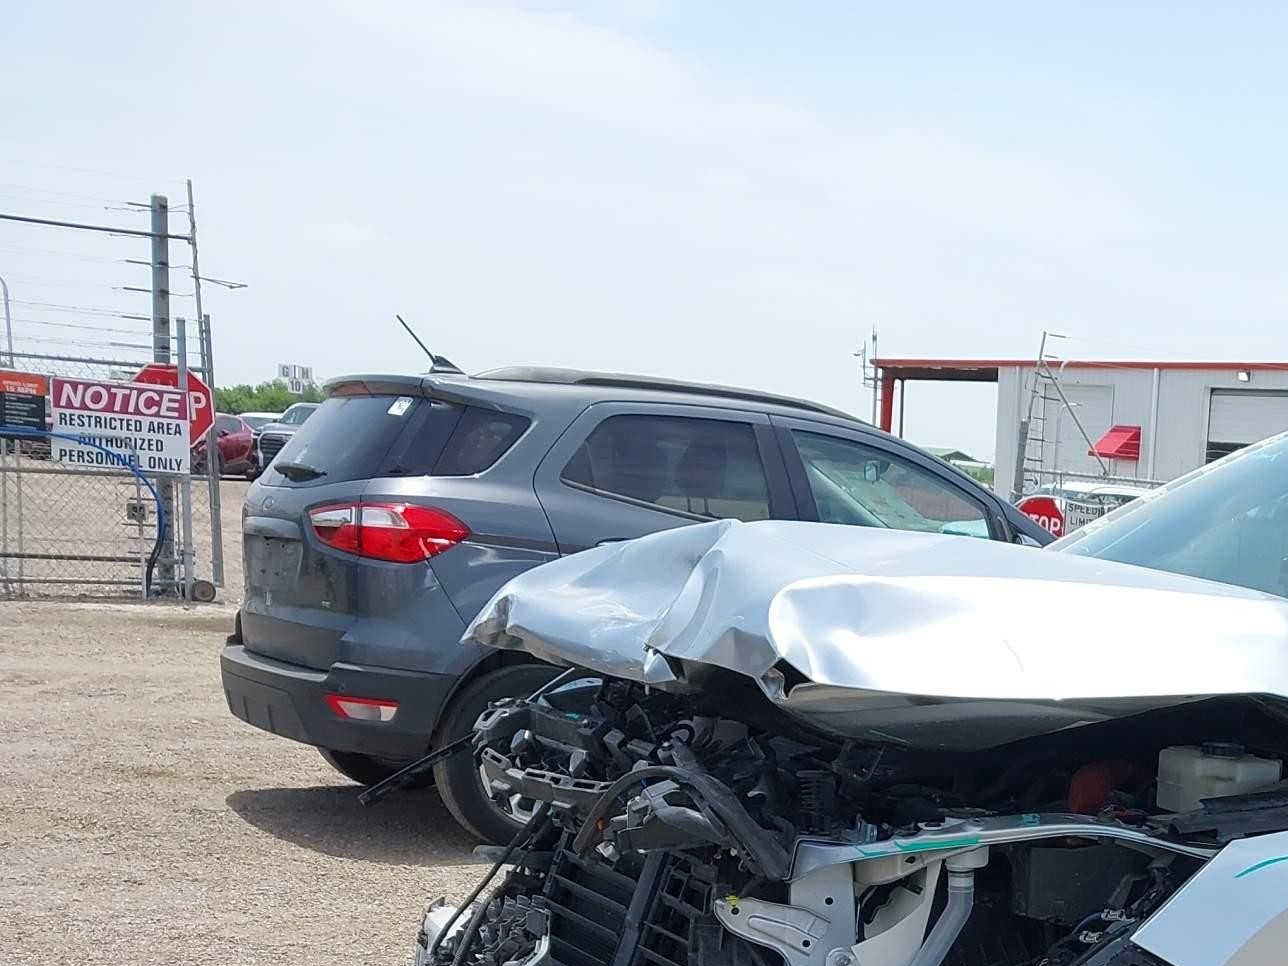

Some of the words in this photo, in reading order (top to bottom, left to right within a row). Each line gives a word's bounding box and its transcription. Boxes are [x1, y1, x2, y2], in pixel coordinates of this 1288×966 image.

[59, 383, 181, 418] NOTICE
[59, 412, 143, 433] RESTRICTED
[148, 421, 183, 437] AREA
[59, 448, 143, 468] PERSONNEL
[148, 456, 183, 472] ONLY
[1068, 503, 1098, 515] SPEED
